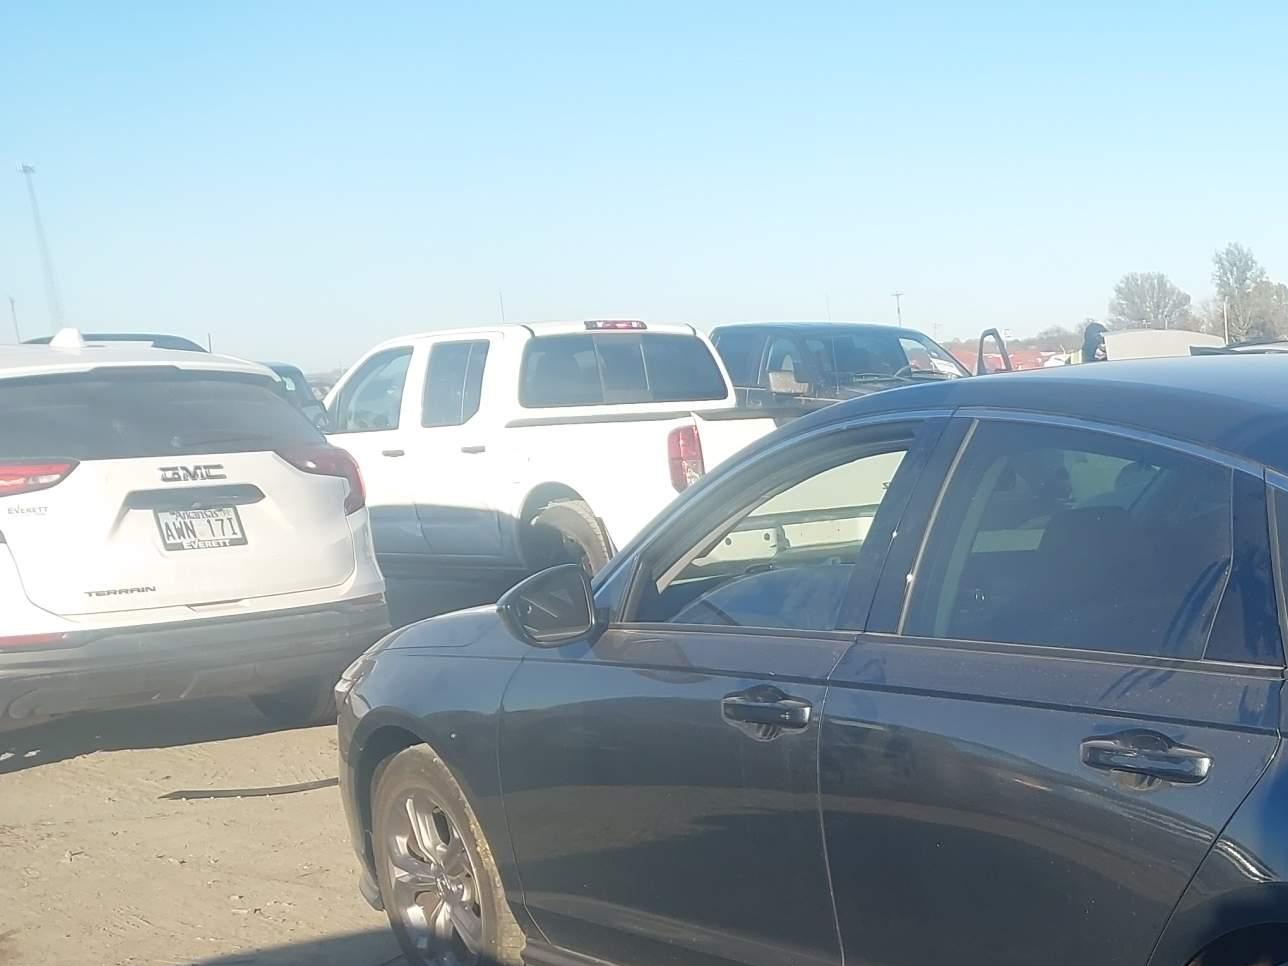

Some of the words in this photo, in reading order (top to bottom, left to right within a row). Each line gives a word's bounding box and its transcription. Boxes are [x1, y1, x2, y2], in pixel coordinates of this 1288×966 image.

[158, 464, 227, 482] GMC
[164, 519, 198, 541] AWN
[182, 538, 231, 549] EVERETT
[84, 585, 157, 598] TERRAIN
